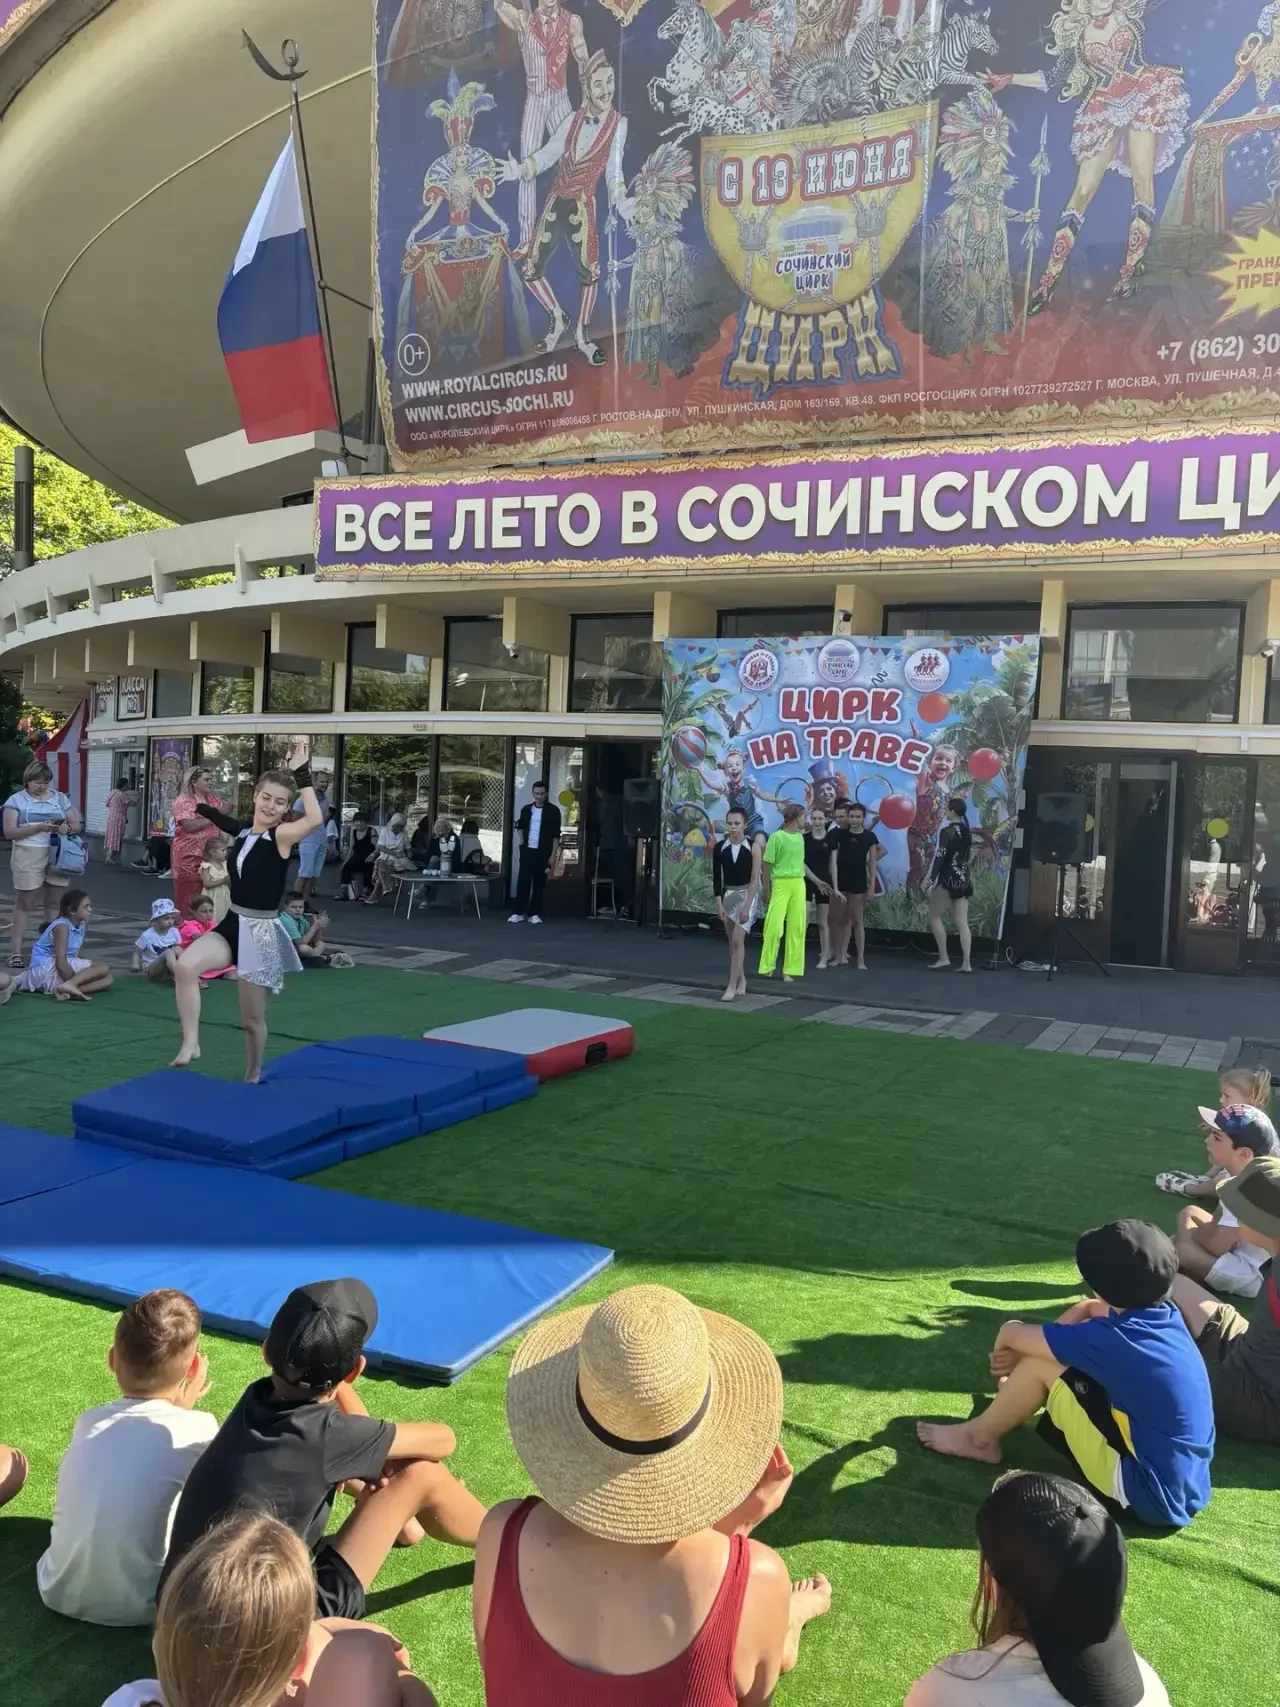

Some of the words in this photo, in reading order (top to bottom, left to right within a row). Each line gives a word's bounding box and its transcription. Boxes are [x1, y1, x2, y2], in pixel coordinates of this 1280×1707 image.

[721, 162, 739, 201] С
[755, 159, 790, 201] 13
[805, 134, 914, 196] ИЮНЯ
[775, 248, 851, 275] СОЧИНСКИЙ
[796, 273, 830, 292] ЦИРК
[403, 343, 426, 366] 0+
[727, 289, 899, 394] ЦИРК
[1156, 340, 1183, 362] +7
[1189, 335, 1245, 365] (862)
[401, 363, 569, 399] WWW.ROYALCIRCUS.RU
[404, 389, 575, 424] WWW.CIRCUS-SOCHI.RU
[410, 432, 428, 442] ООО
[515, 421, 538, 432] ОГРН
[600, 406, 683, 422] РОСТОВ-НА-ДОНУ,
[704, 399, 778, 415] ПУШКИНСКАЯ,
[779, 398, 802, 411] ДОМ
[878, 392, 901, 404] ФКП
[904, 387, 977, 402] РОСГОСЦИРК
[980, 386, 1009, 398] ОГРН
[1012, 380, 1092, 396] 1027739272527
[1095, 379, 1104, 391] Г.
[1107, 375, 1161, 390] МОСКВА,
[1164, 372, 1182, 385] УЛ.
[1186, 367, 1260, 382] ПУШЕЧНАЯ,
[335, 500, 433, 552] ВСЕ
[449, 492, 601, 550] ЛЕТО
[620, 490, 659, 545] В
[676, 460, 1149, 542] СОЧИНСКОМ
[121, 676, 145, 693] КАССА
[779, 688, 902, 724] ЦИРК
[749, 732, 799, 769] НА
[806, 728, 930, 774] ТРАВЕ
